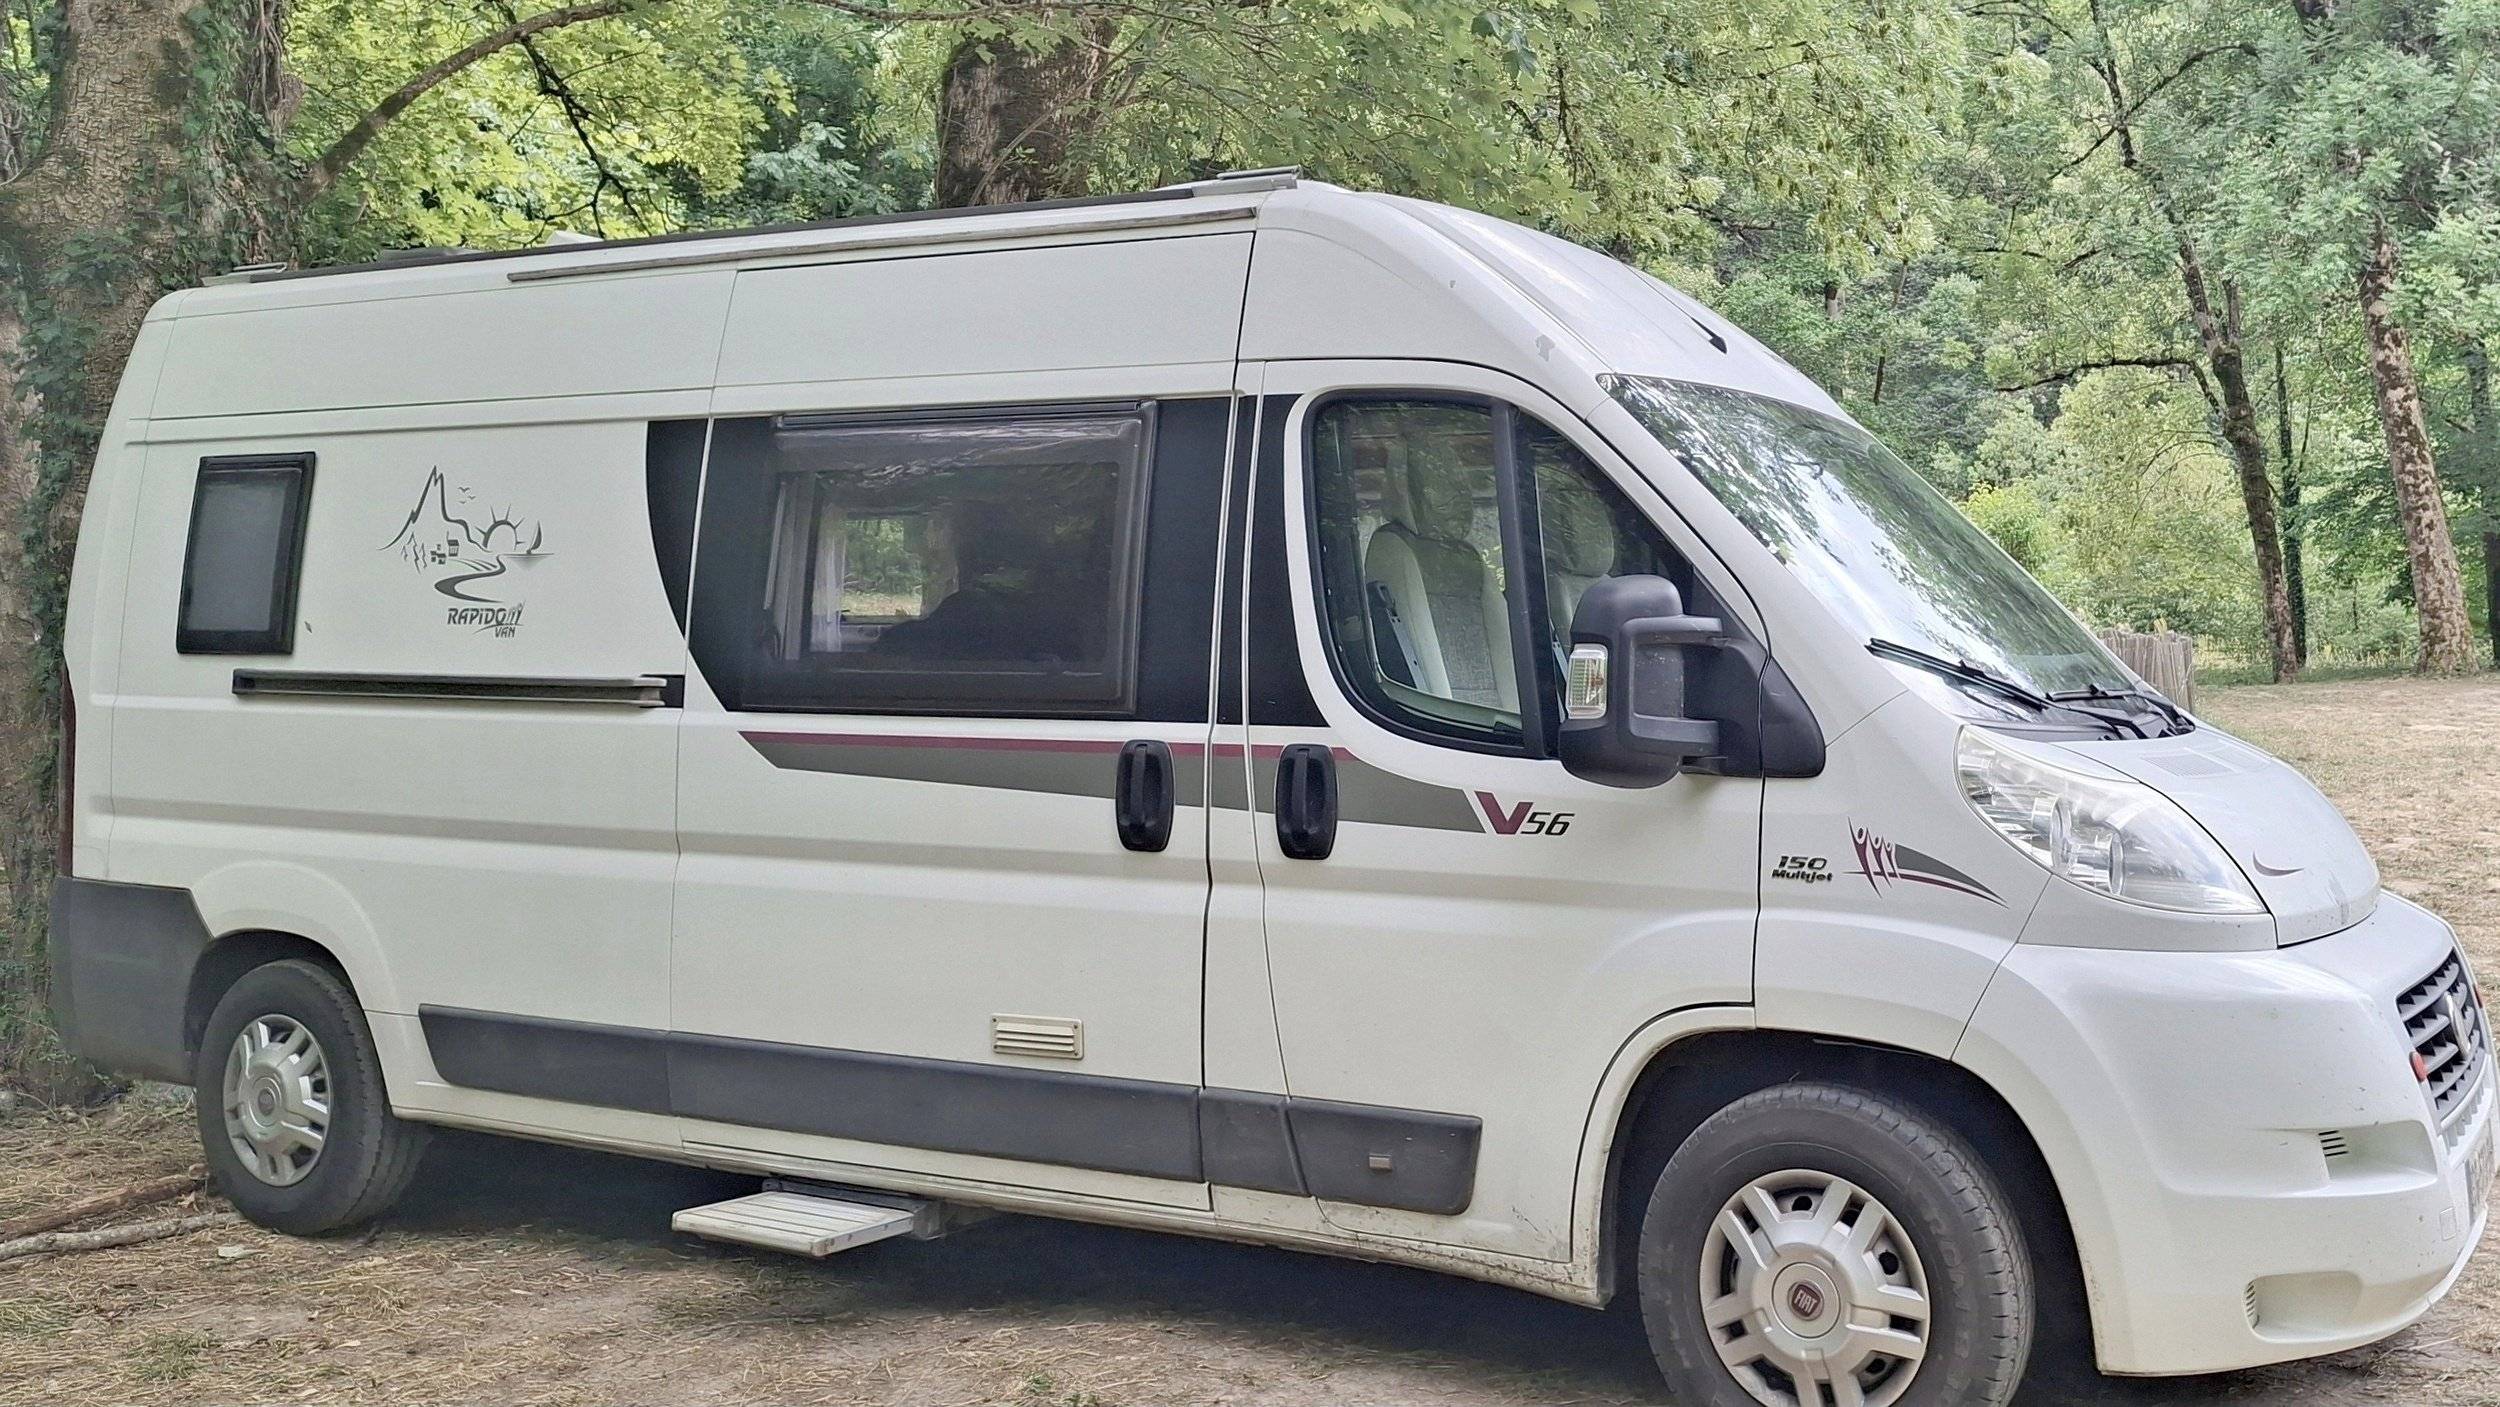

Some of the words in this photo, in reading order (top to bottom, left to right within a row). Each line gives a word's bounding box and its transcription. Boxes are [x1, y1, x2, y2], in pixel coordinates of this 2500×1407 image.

[495, 627, 516, 638] VAN
[1473, 790, 1575, 836] V56
[1778, 855, 1827, 870] 150
[1771, 868, 1833, 884] Multijet
[1793, 1289, 1818, 1314] FIAT
